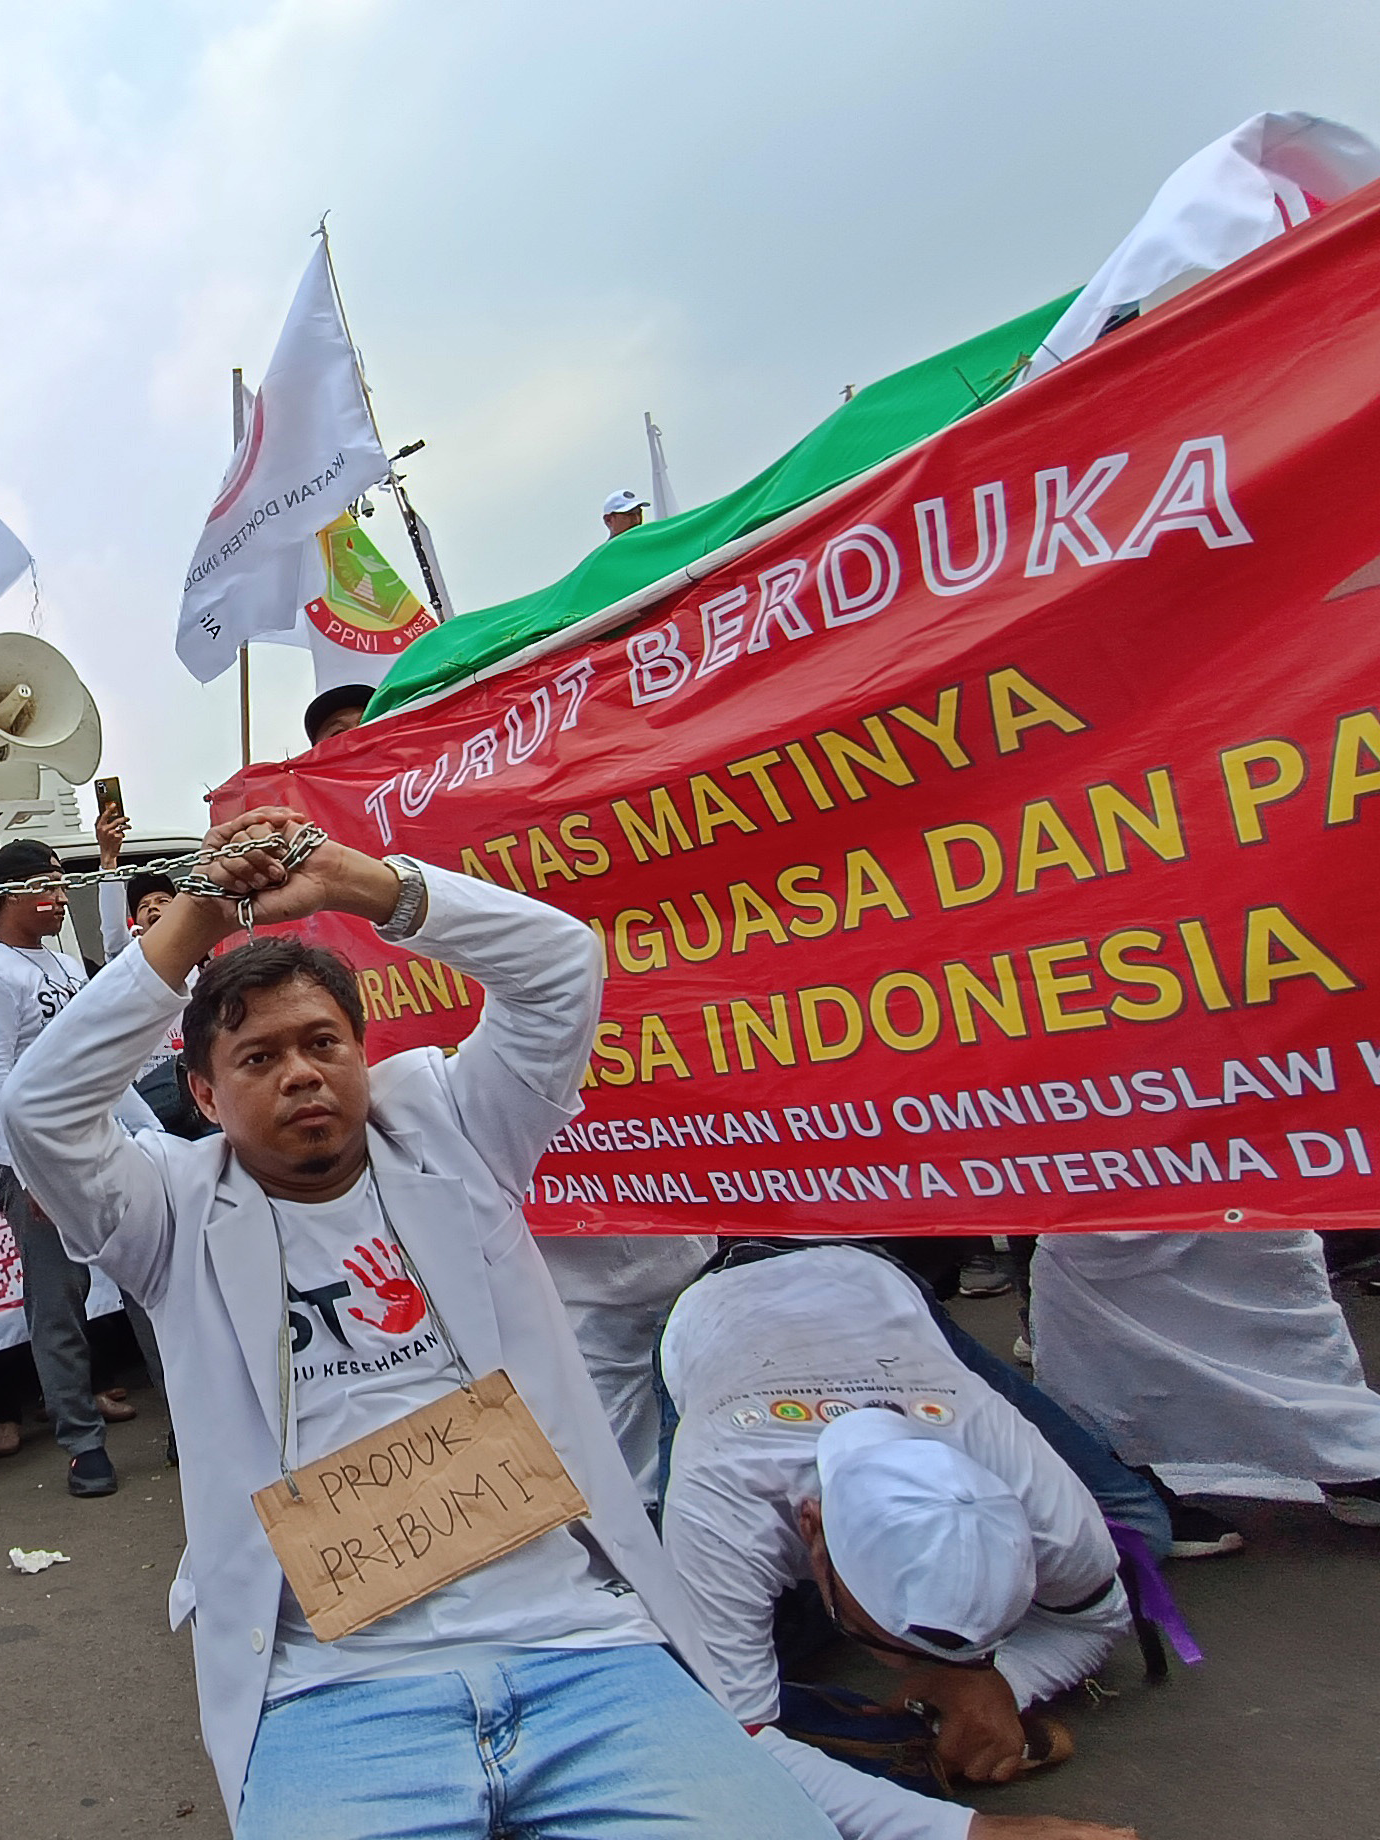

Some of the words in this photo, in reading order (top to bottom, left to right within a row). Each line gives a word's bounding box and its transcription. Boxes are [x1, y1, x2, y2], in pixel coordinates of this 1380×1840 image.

[324, 619, 378, 652] PPNI
[364, 657, 596, 847] TURUT
[626, 434, 1254, 707] BERDUKA
[460, 814, 610, 893] ATAS
[610, 666, 1089, 864] MATINYA
[922, 768, 1187, 910] DAN
[702, 906, 1358, 1074] INDONESIA
[782, 1100, 882, 1142] RUU
[892, 1047, 1337, 1135] OMNIBUSLAW
[541, 1173, 610, 1204] DAN
[615, 1171, 708, 1205] AMAL
[708, 1162, 959, 1204] BURUKNYA
[960, 1137, 1278, 1197] DITERIMA
[1285, 1127, 1372, 1178] DI
[323, 1331, 439, 1378] KESEHATAN
[318, 1417, 472, 1515] PRODUK
[319, 1459, 535, 1597] PRIBUMI
